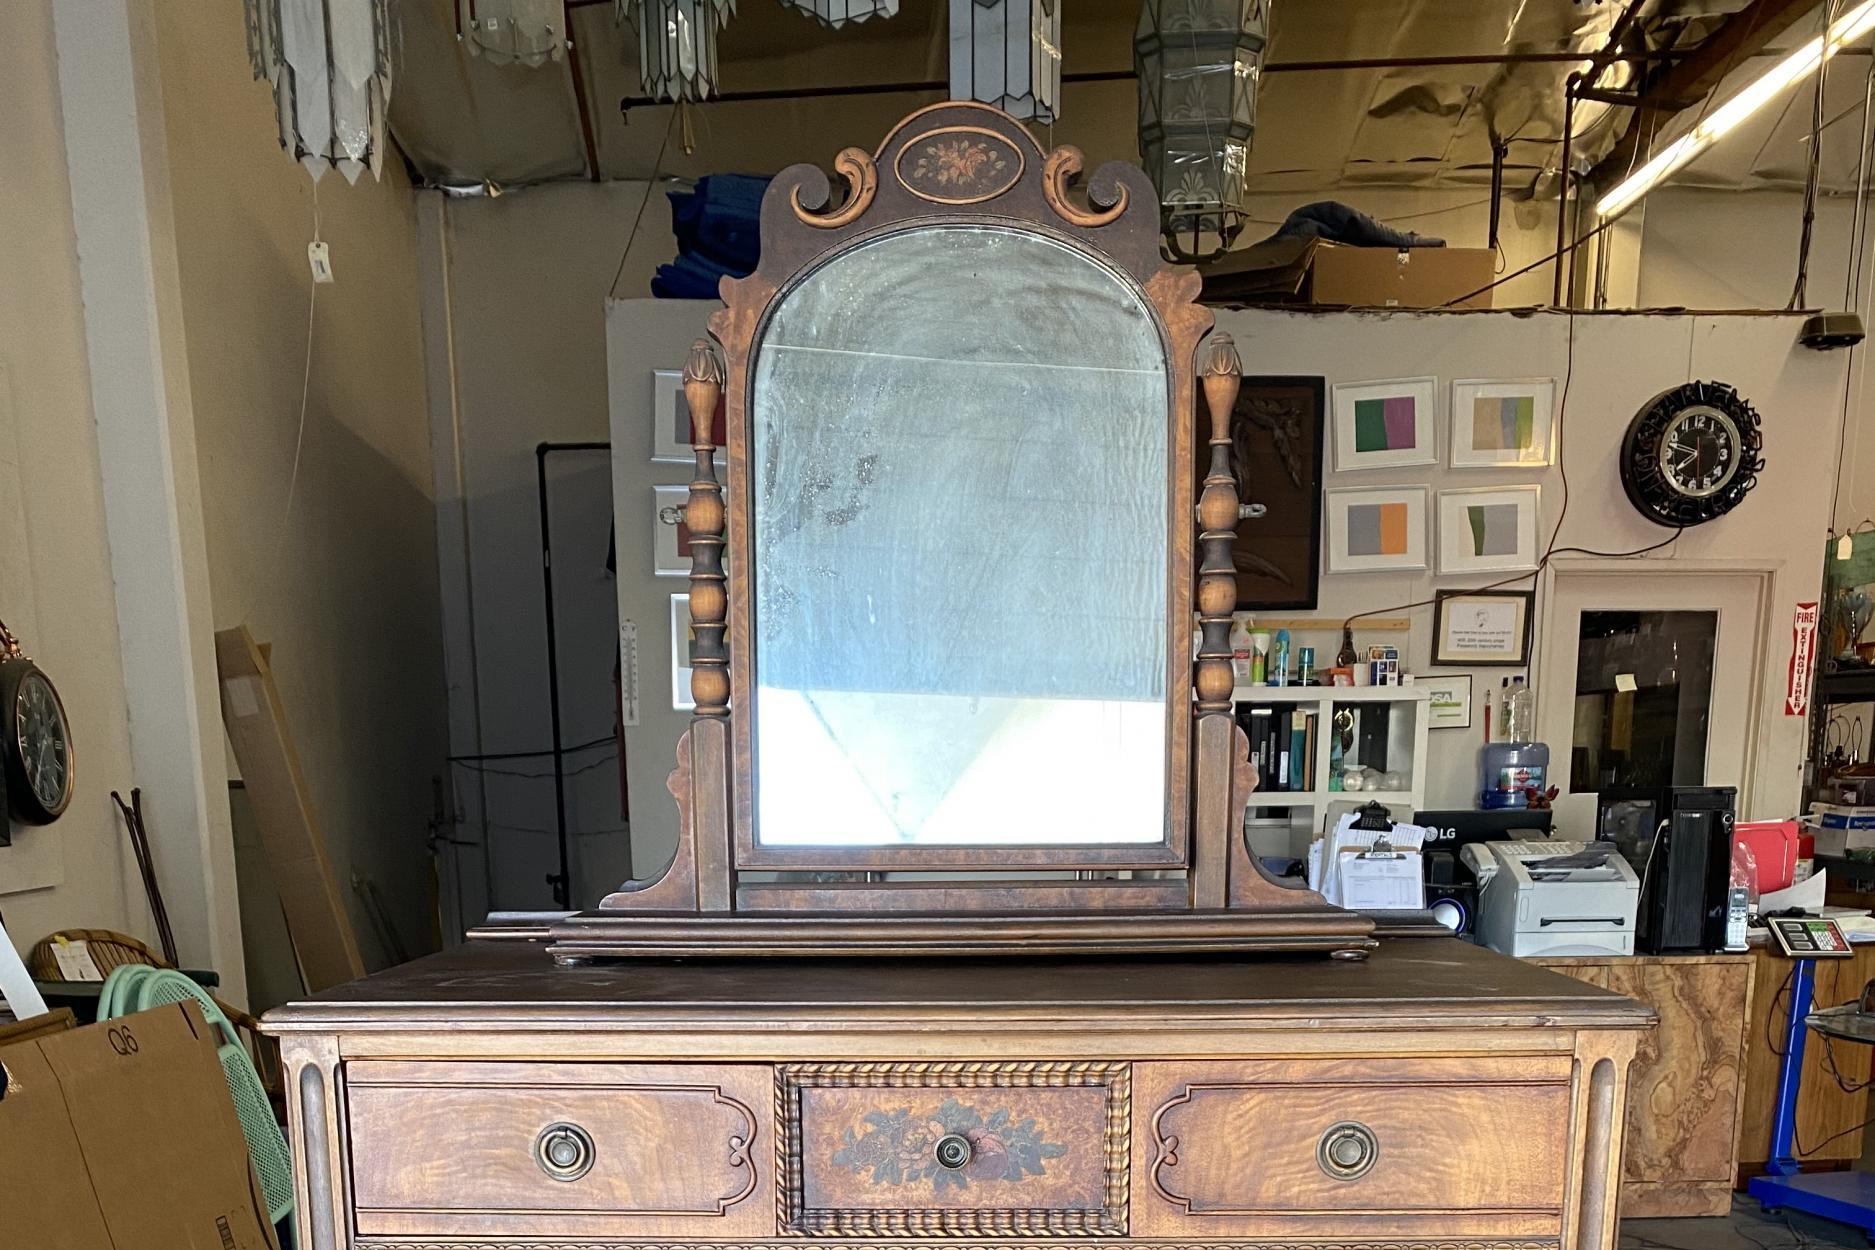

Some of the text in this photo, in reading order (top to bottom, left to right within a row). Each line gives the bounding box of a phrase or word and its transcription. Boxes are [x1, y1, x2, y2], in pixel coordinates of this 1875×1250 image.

[1694, 415, 1706, 428] 12
[1719, 432, 1727, 444] 2
[1719, 448, 1728, 460] 3
[1713, 465, 1722, 477] 4
[1703, 477, 1712, 489] 5
[1797, 612, 1814, 623] FIRE
[1794, 627, 1808, 709] EXTINGUISHER
[1439, 827, 1456, 840] LG
[107, 1025, 139, 1057] Q6
